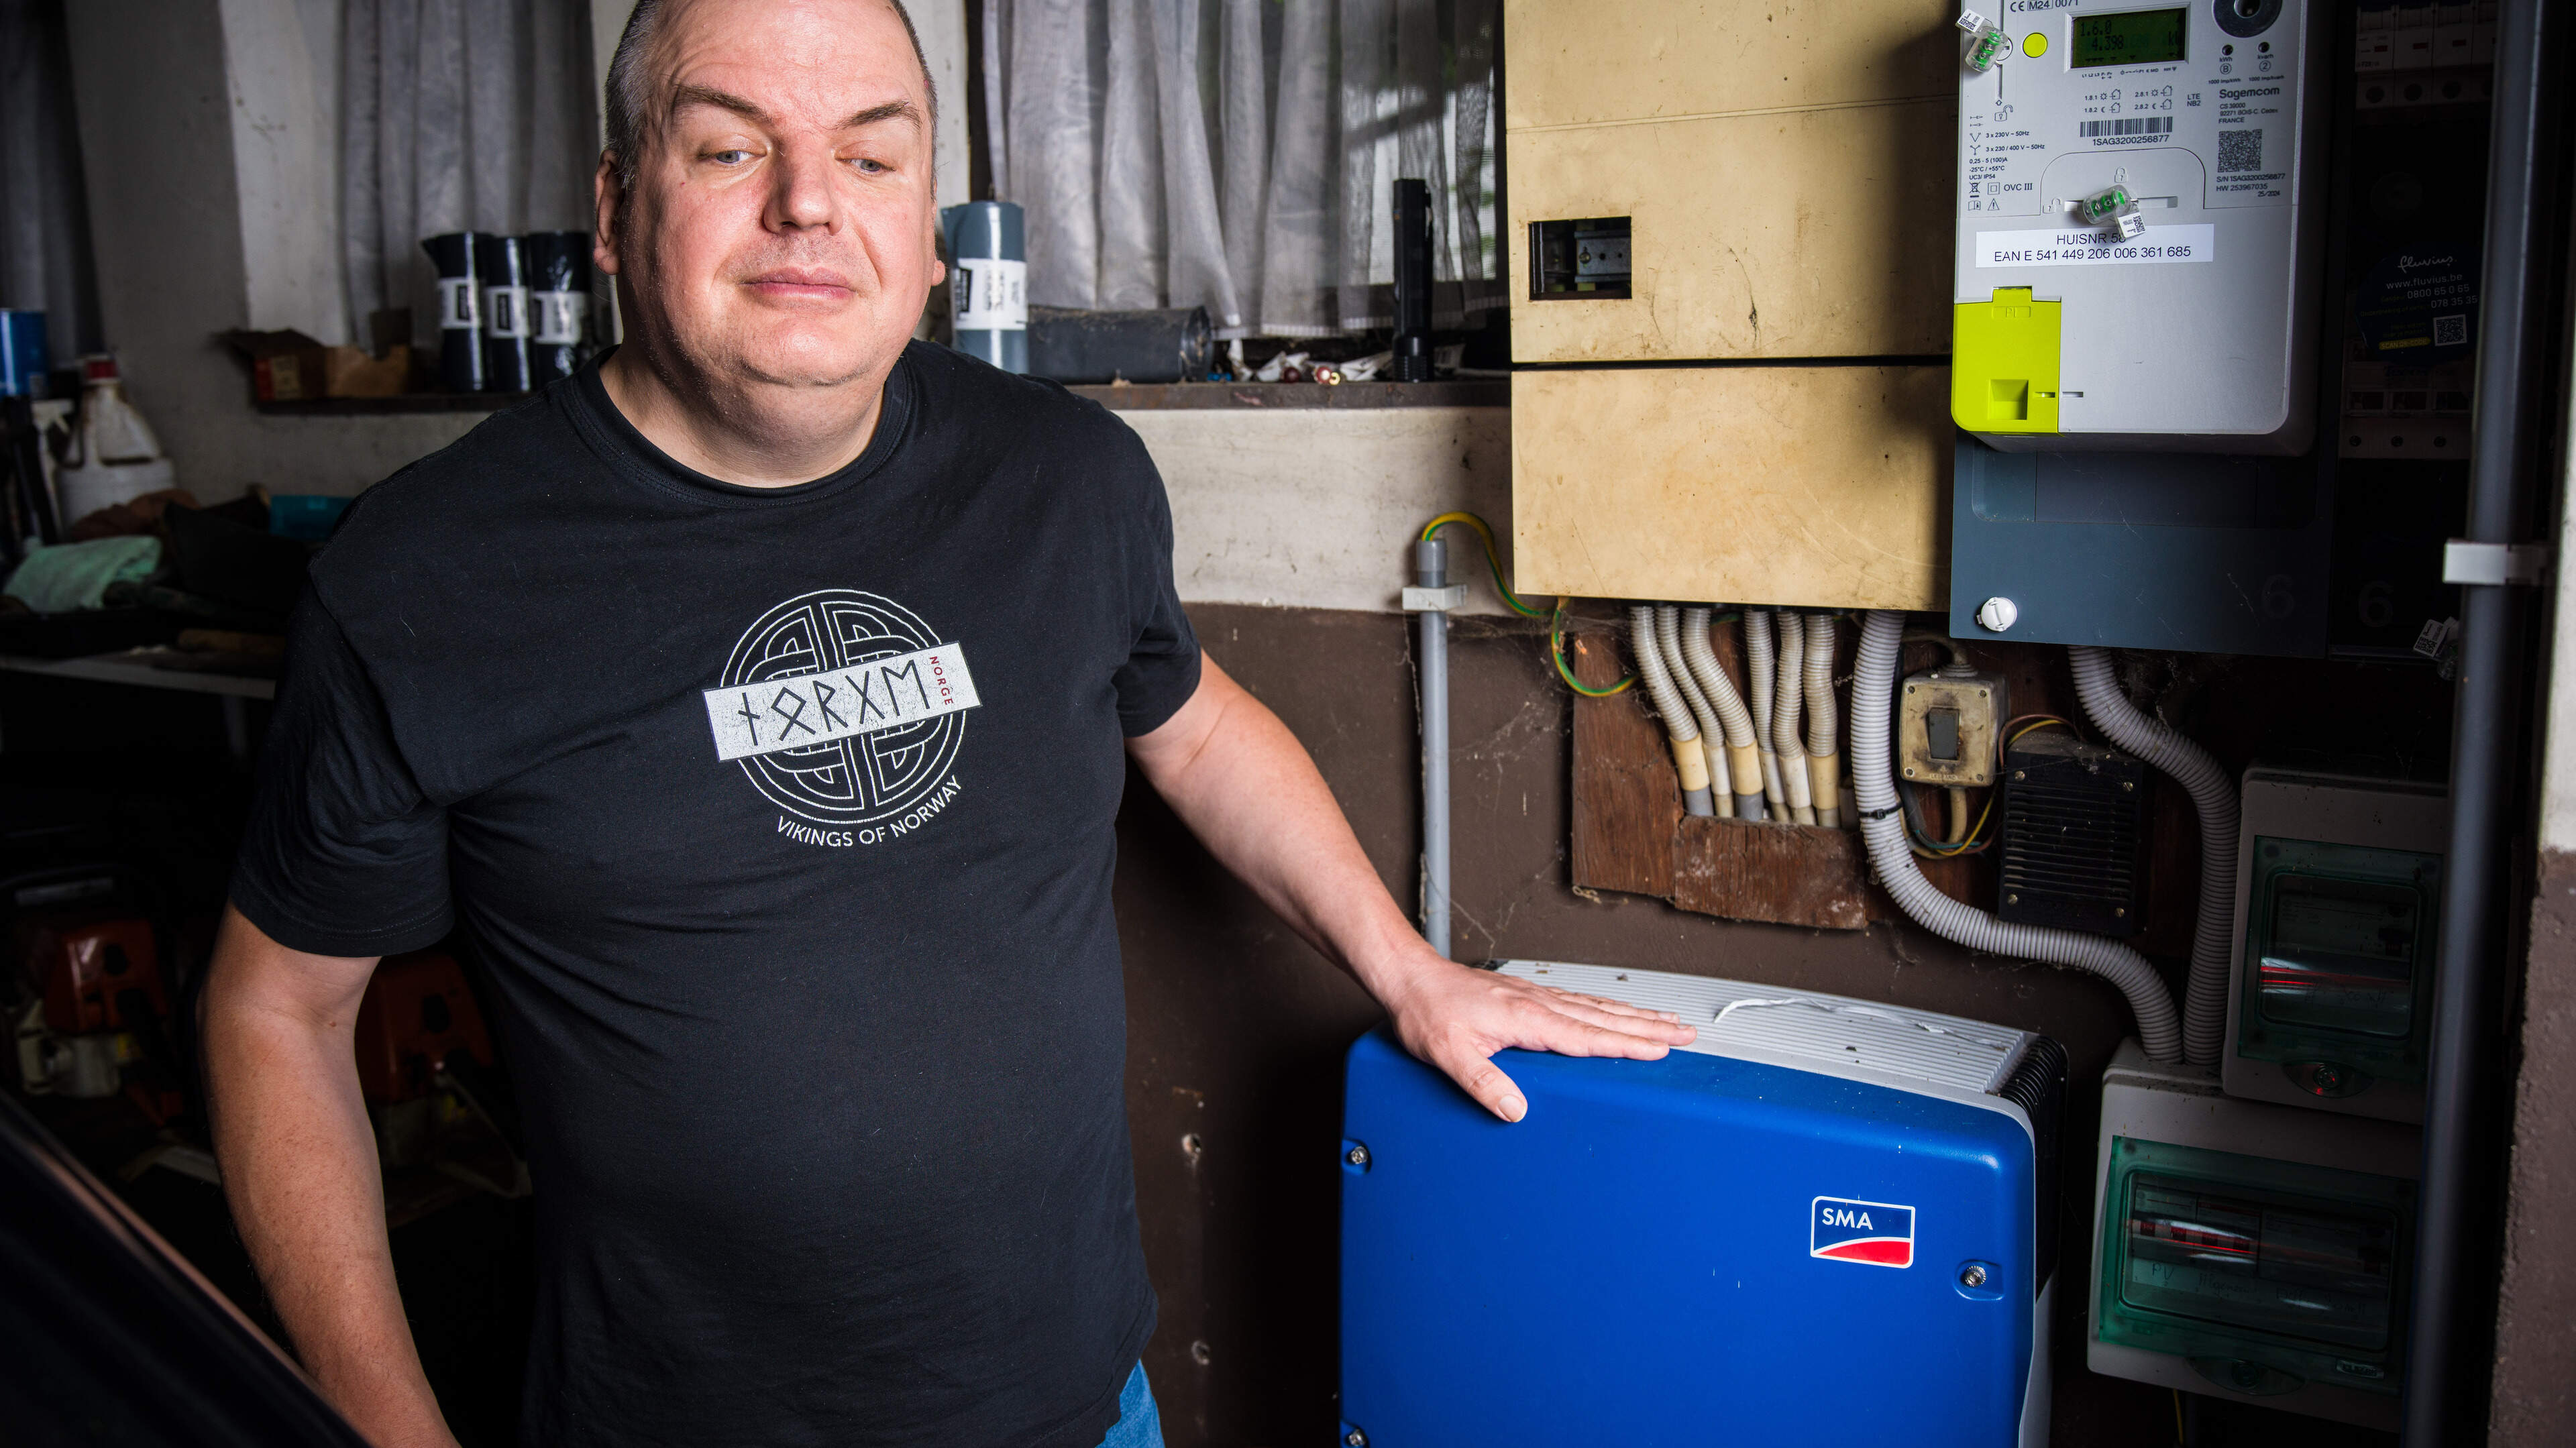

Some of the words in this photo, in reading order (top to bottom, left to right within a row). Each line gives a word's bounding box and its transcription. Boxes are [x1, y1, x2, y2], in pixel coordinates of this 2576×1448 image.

[2029, 1, 2051, 10] M24
[2081, 19, 2112, 36] 1.6.0
[2219, 87, 2279, 100] Sagemcom
[2092, 134, 2169, 146] 1SAG3200256877
[2004, 183, 2022, 192] OVC
[2024, 182, 2033, 190] III
[2056, 233, 2107, 245] HUISNR
[1994, 250, 2021, 262] EAN
[2025, 249, 2032, 261] E
[2036, 249, 2057, 261] 541
[2061, 248, 2084, 260] 449
[2088, 247, 2110, 260] 206
[2114, 247, 2137, 259] 006
[2140, 246, 2162, 258] 361
[2167, 245, 2191, 257] 685
[2385, 274, 2463, 290] www.fluvius.be
[2407, 288, 2432, 299] 0800
[2434, 286, 2447, 296] 65
[2449, 286, 2455, 294] 0
[2457, 284, 2470, 293] 65
[2430, 298, 2449, 309] 078
[2451, 296, 2463, 306] 35
[2465, 295, 2478, 304] 35
[930, 656, 954, 706] NORGE
[776, 816, 853, 847] VIKINGS
[859, 826, 886, 845] OF
[890, 775, 963, 838] NORWAY
[1822, 1207, 1874, 1230] SMA
